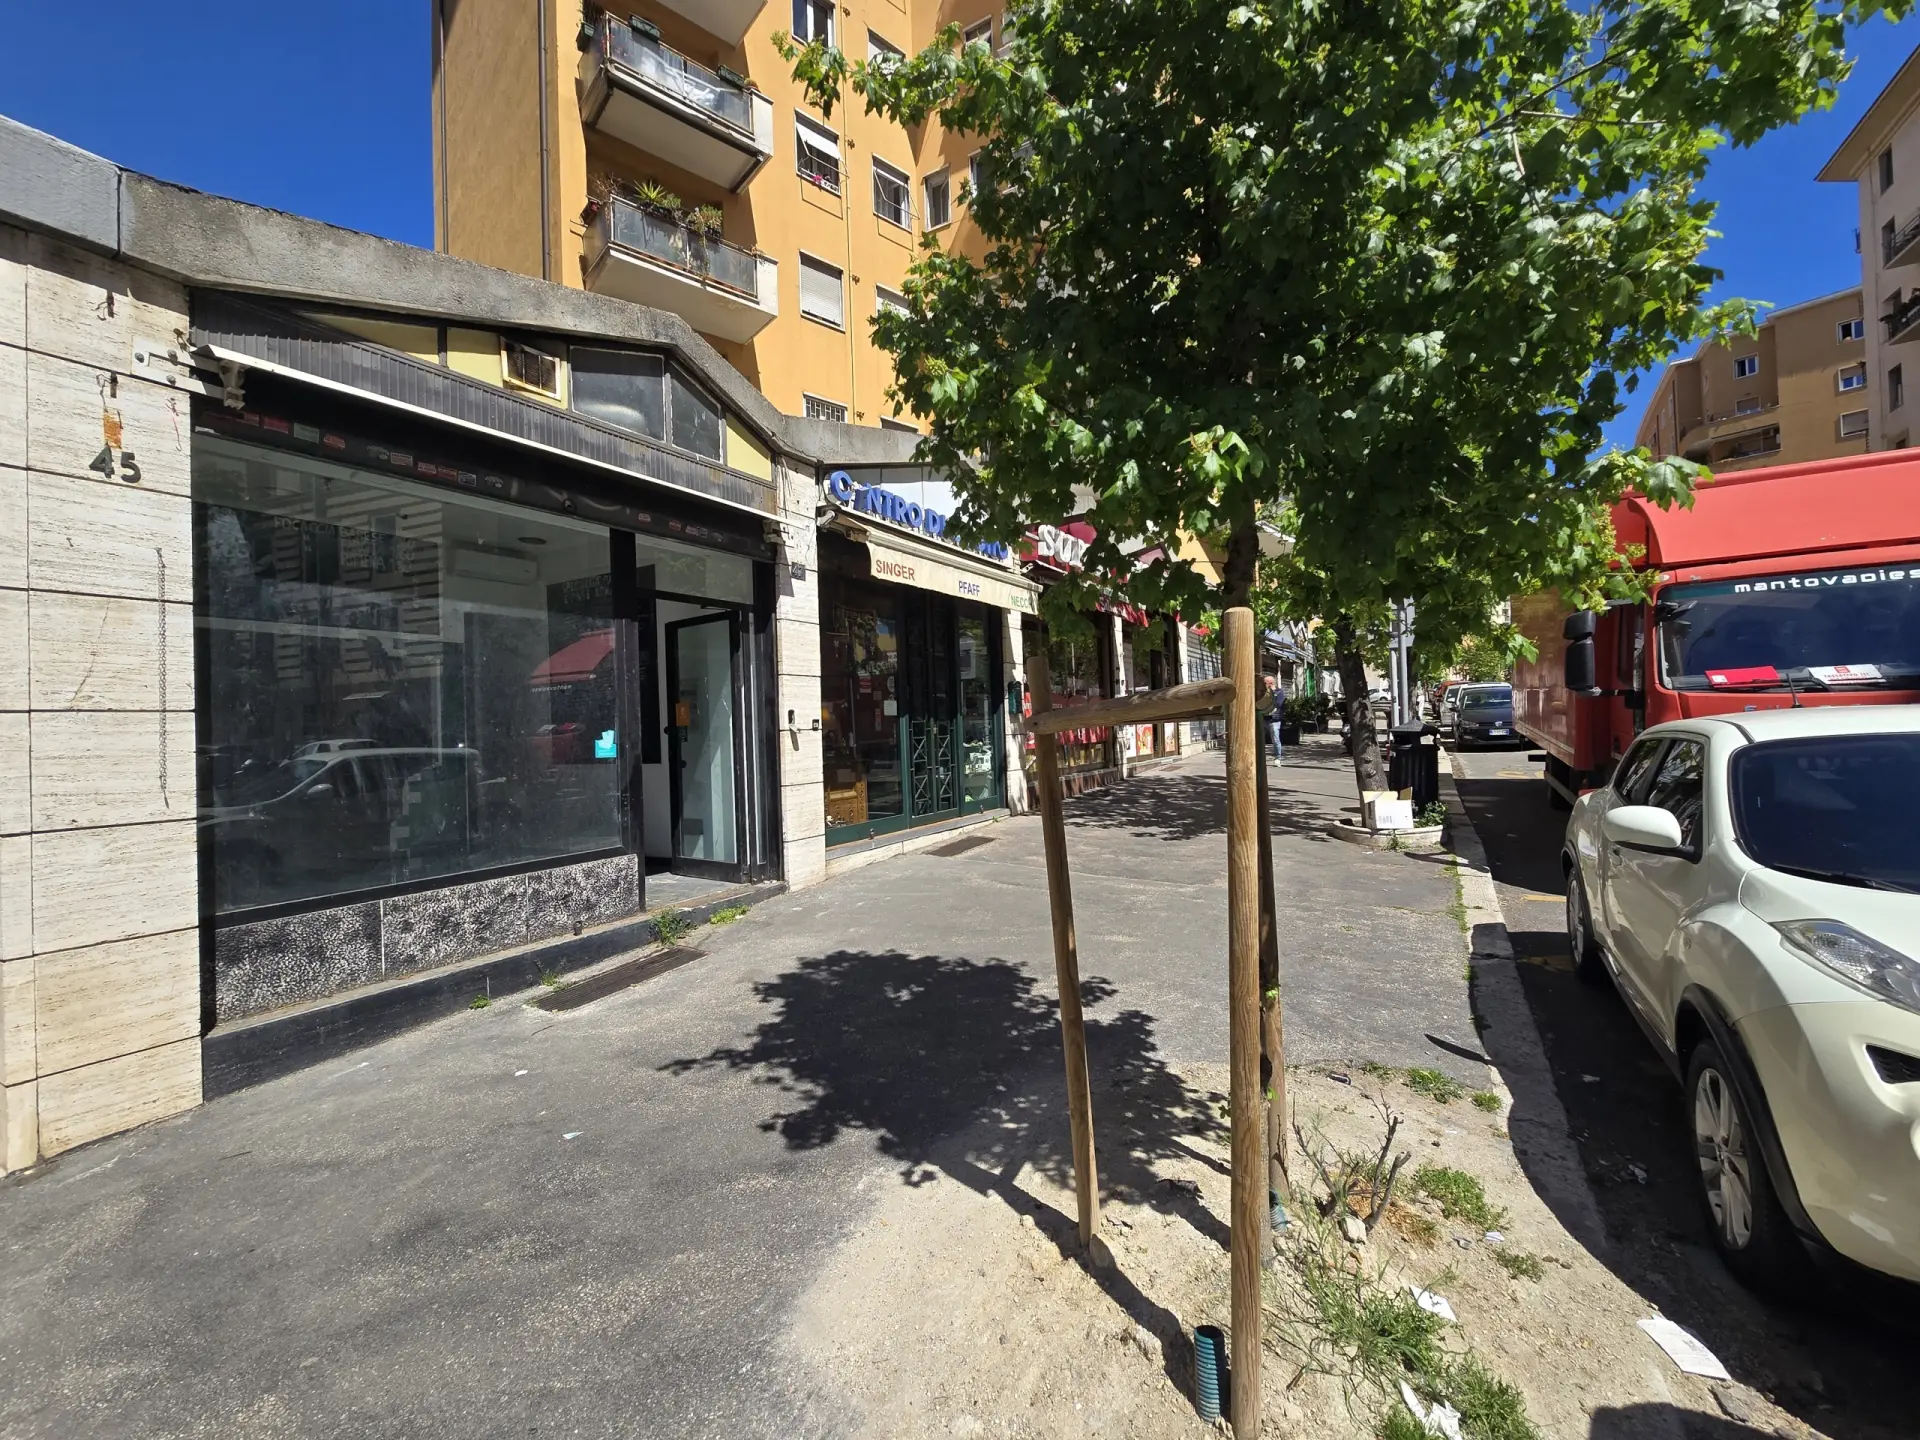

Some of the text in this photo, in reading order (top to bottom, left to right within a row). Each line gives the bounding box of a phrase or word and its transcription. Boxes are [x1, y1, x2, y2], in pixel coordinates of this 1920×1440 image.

[89, 442, 141, 484] 45
[875, 559, 915, 581] SINGER
[958, 580, 980, 596] PFAFF
